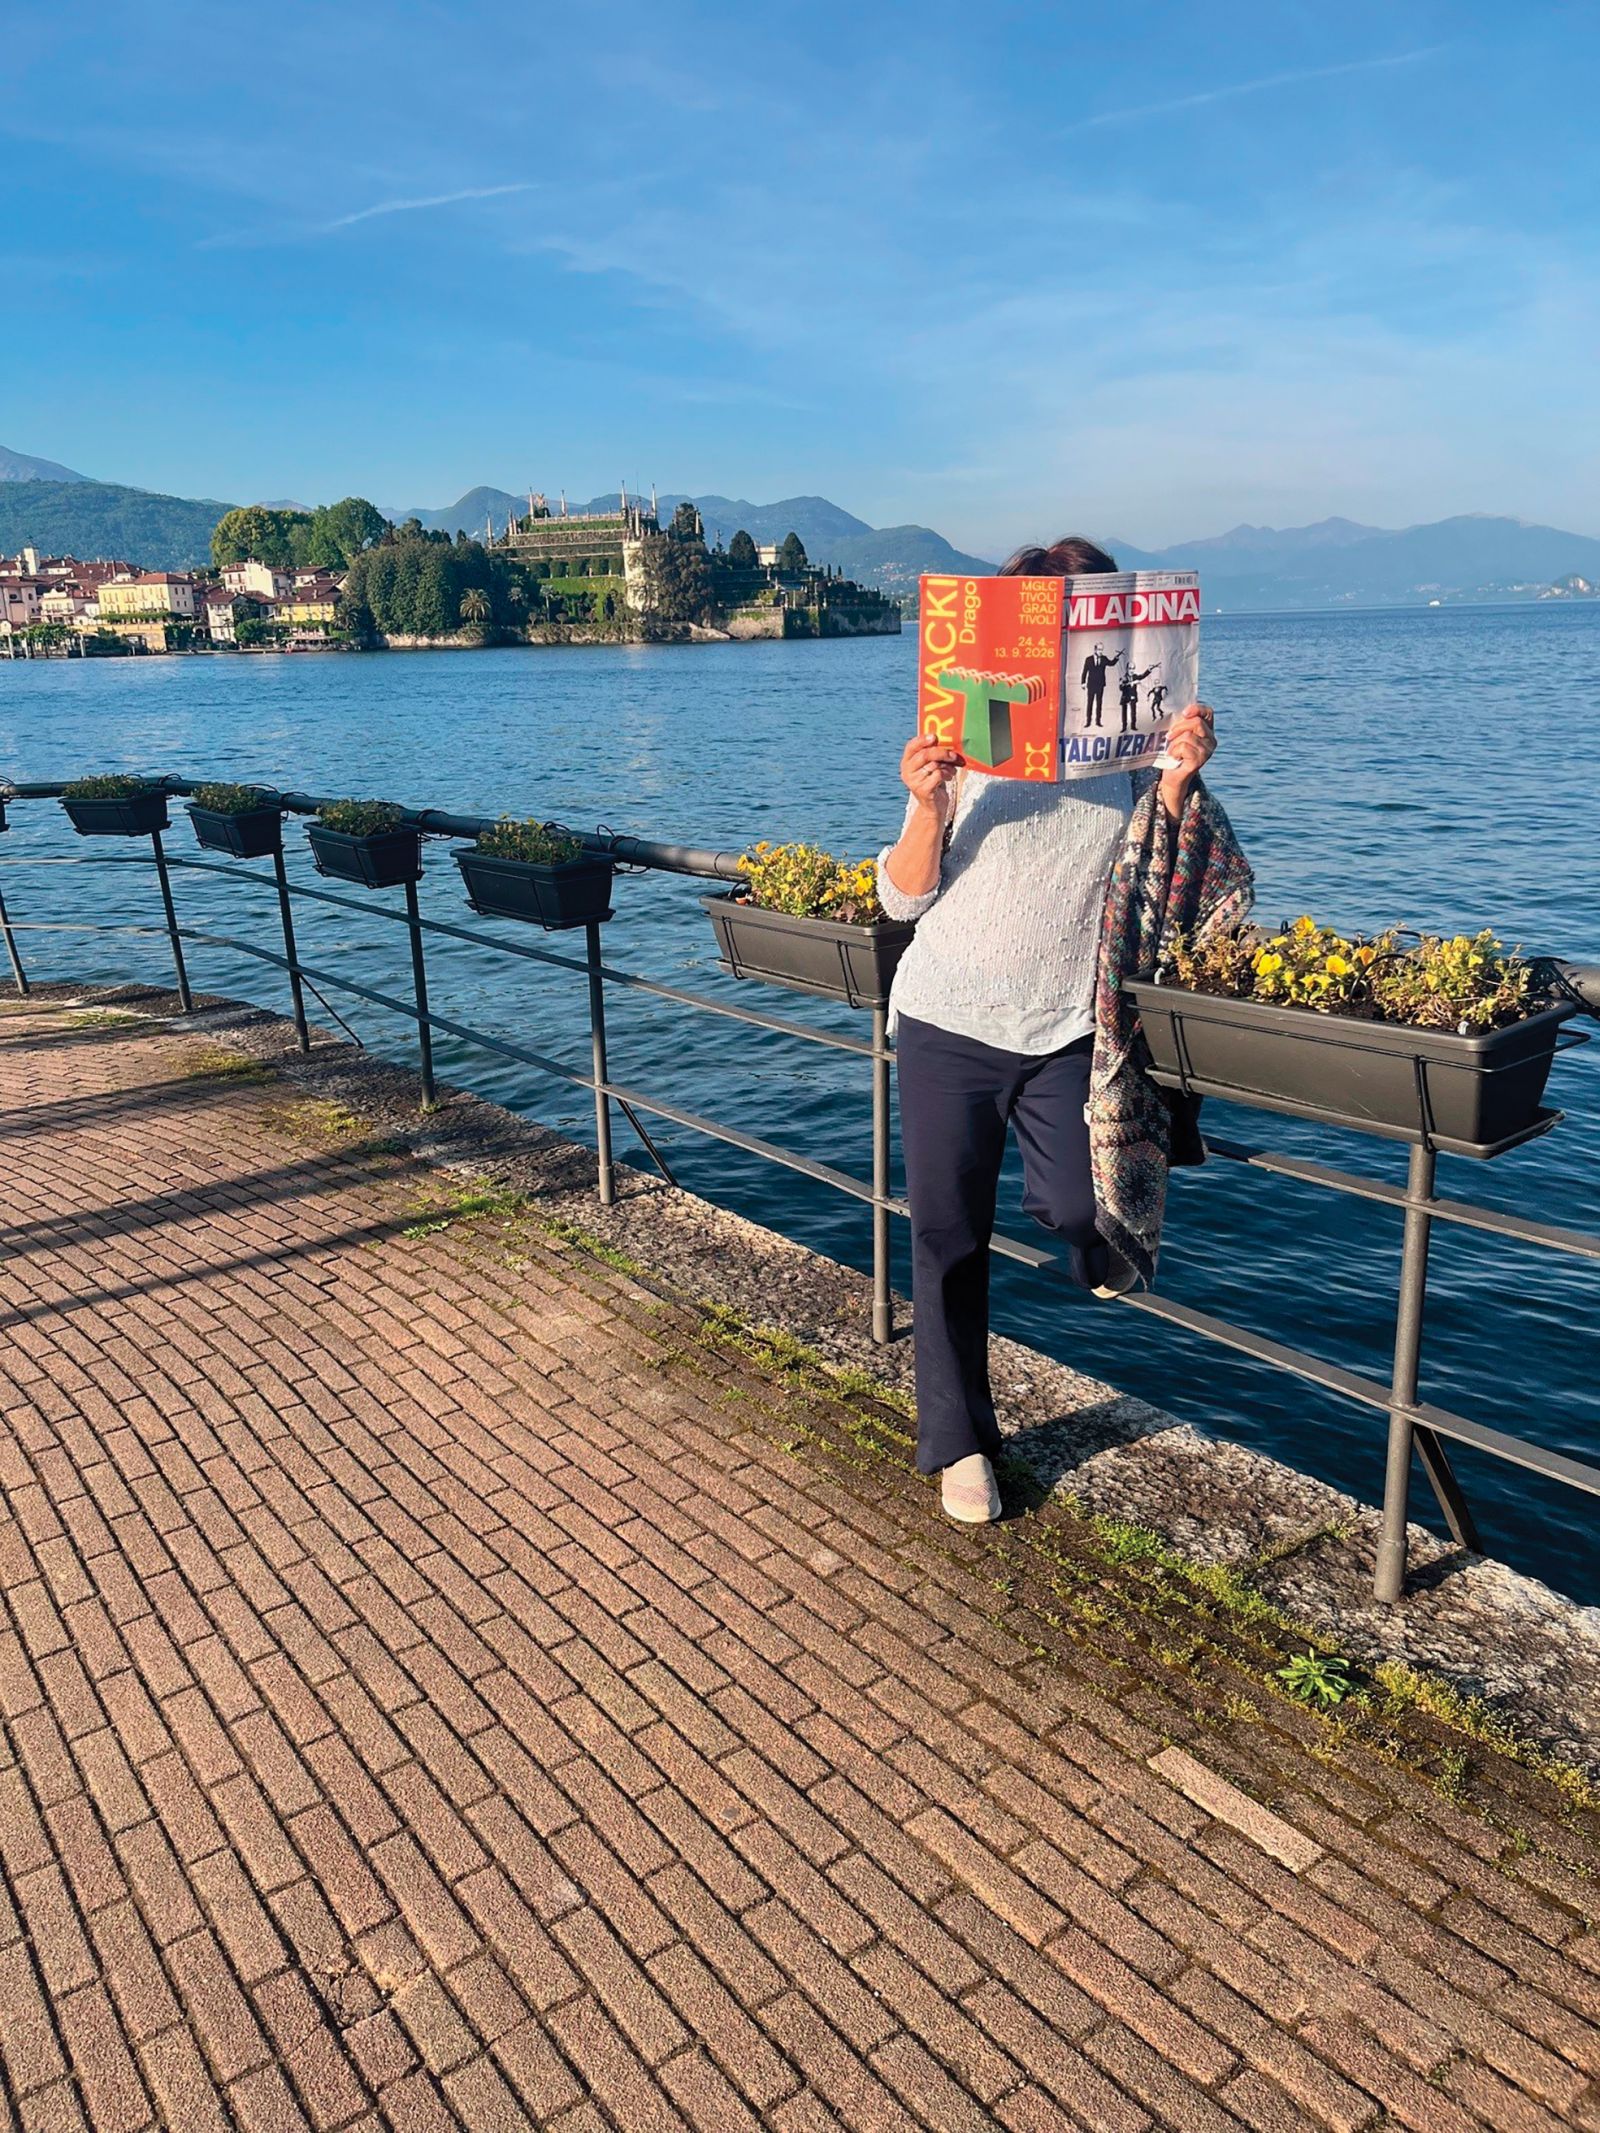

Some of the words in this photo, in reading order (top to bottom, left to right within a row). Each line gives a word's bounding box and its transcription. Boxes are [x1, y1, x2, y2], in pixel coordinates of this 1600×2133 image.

[1021, 580, 1057, 591] MGLC
[1019, 591, 1057, 602] TIVOLI
[959, 581, 982, 644] Drago
[1022, 602, 1057, 614] GRAD
[1063, 591, 1200, 627] MLADINA
[1018, 613, 1056, 625] TIVOLI
[1025, 647, 1055, 658] 2026
[924, 578, 958, 750] RVACKI
[1059, 736, 1111, 763] TALCI
[1115, 731, 1169, 758] IZRAE
